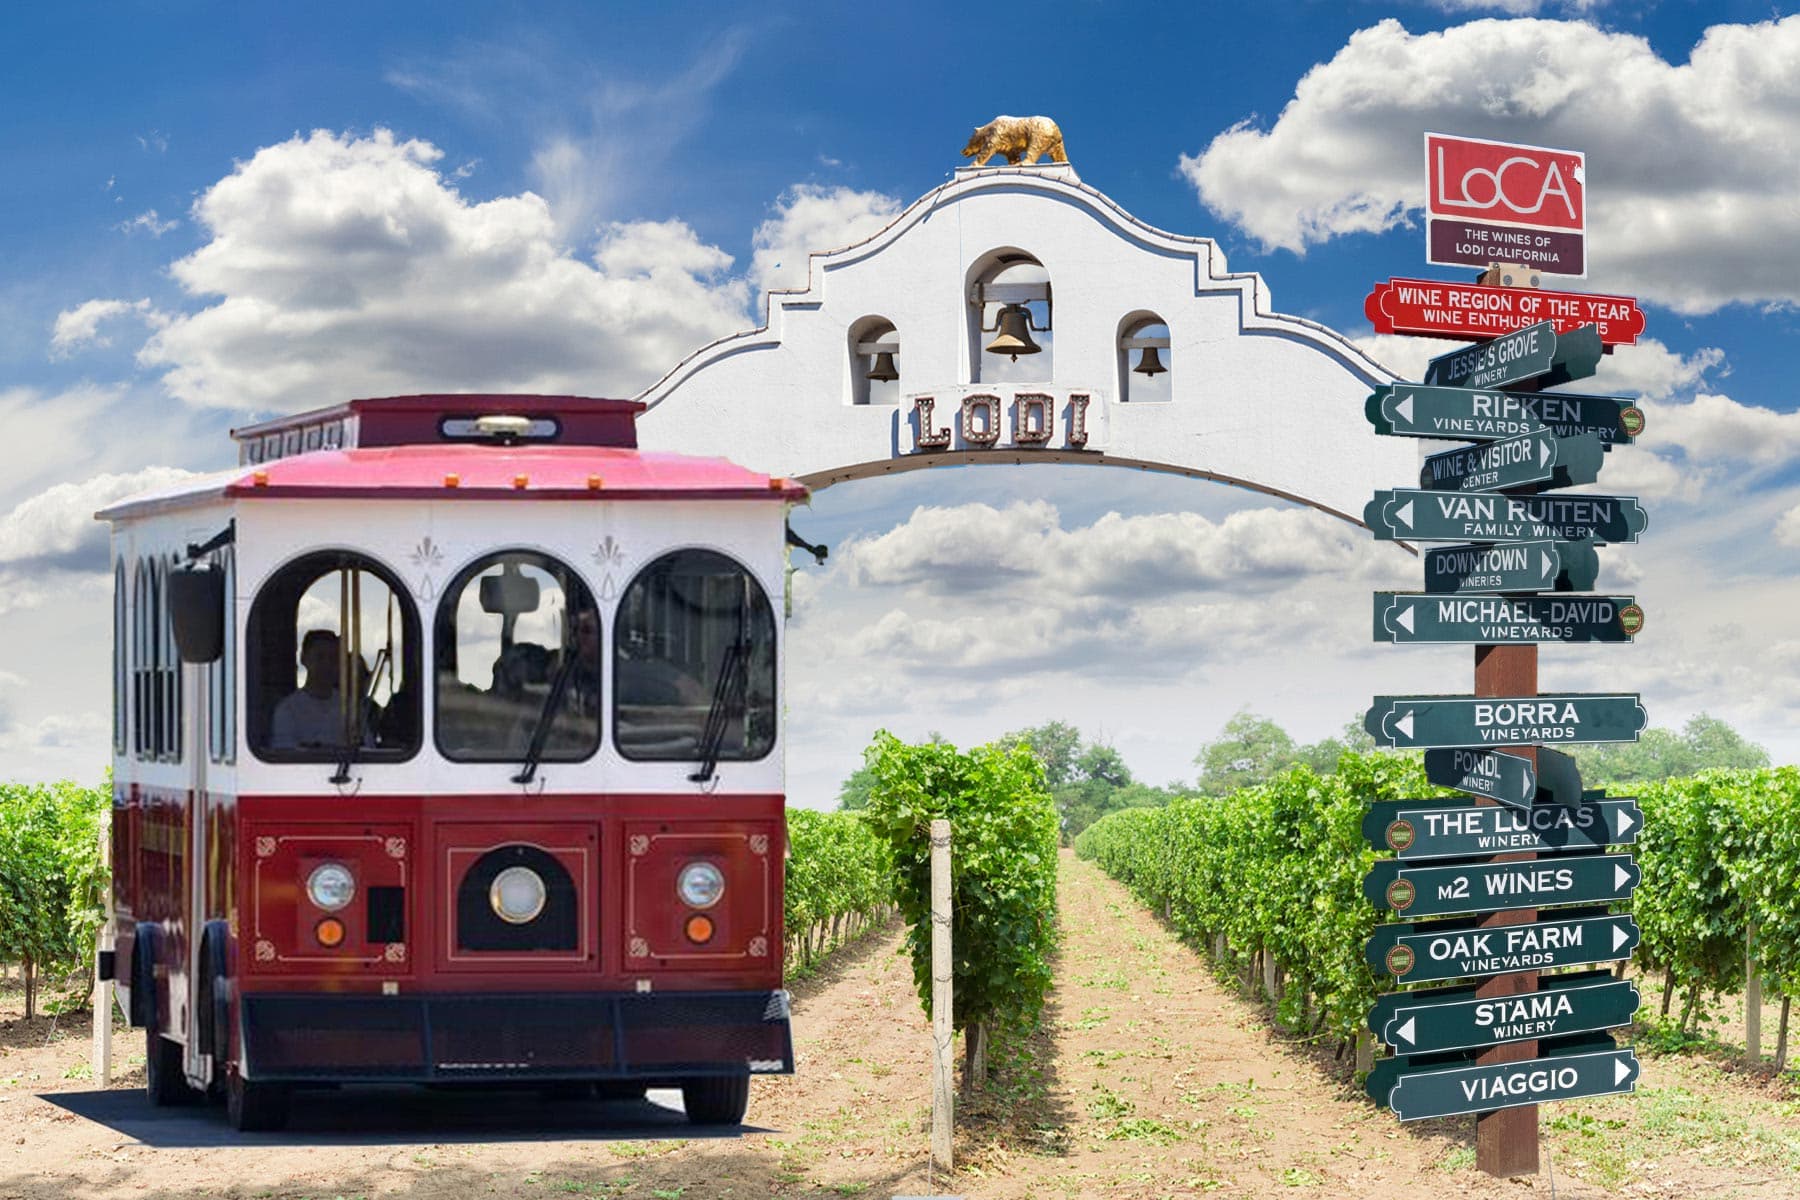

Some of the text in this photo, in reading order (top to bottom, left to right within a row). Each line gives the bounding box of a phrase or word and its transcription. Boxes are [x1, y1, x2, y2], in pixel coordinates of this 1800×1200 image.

[1465, 229, 1551, 248] THE WINES OF
[1456, 243, 1560, 263] LODI CALIFORNIA
[1398, 287, 1631, 322] WINE REGION OF THE YEAR
[1423, 309, 1463, 325] WINE
[1577, 320, 1609, 336] 215
[1448, 331, 1539, 380] JESSIE'S GROVE
[1474, 366, 1508, 386] WINERY
[914, 393, 1090, 447] LODI
[1472, 394, 1581, 422] RIPKEN
[1433, 417, 1530, 434] VINEYARDS
[1432, 438, 1532, 480] WINE & VISITOR
[1462, 471, 1499, 489] CENTER
[1437, 497, 1611, 524] VAN RUITEN
[1464, 523, 1597, 538] FAMILY WINERY
[1436, 548, 1527, 574] DOWNTOWN
[1438, 601, 1613, 624] MICHAEL-DAVID
[1481, 626, 1574, 639] VINEYARDS
[1474, 702, 1580, 727] BORRA
[1481, 727, 1575, 741] VINEYARDS
[1454, 750, 1502, 779] PONDL
[1462, 776, 1494, 792] WINERY
[1423, 812, 1483, 836] THE
[1494, 807, 1594, 833] LUCAS
[1478, 834, 1542, 848] WINERY
[1485, 869, 1573, 896] WINES
[1429, 934, 1492, 961] OAK
[1507, 925, 1583, 952] FARM
[1460, 952, 1554, 973] VINEYARDS
[1474, 994, 1573, 1026] STAMA
[1493, 1019, 1557, 1038] WINERY
[1460, 1067, 1578, 1102] VIAGGIO
